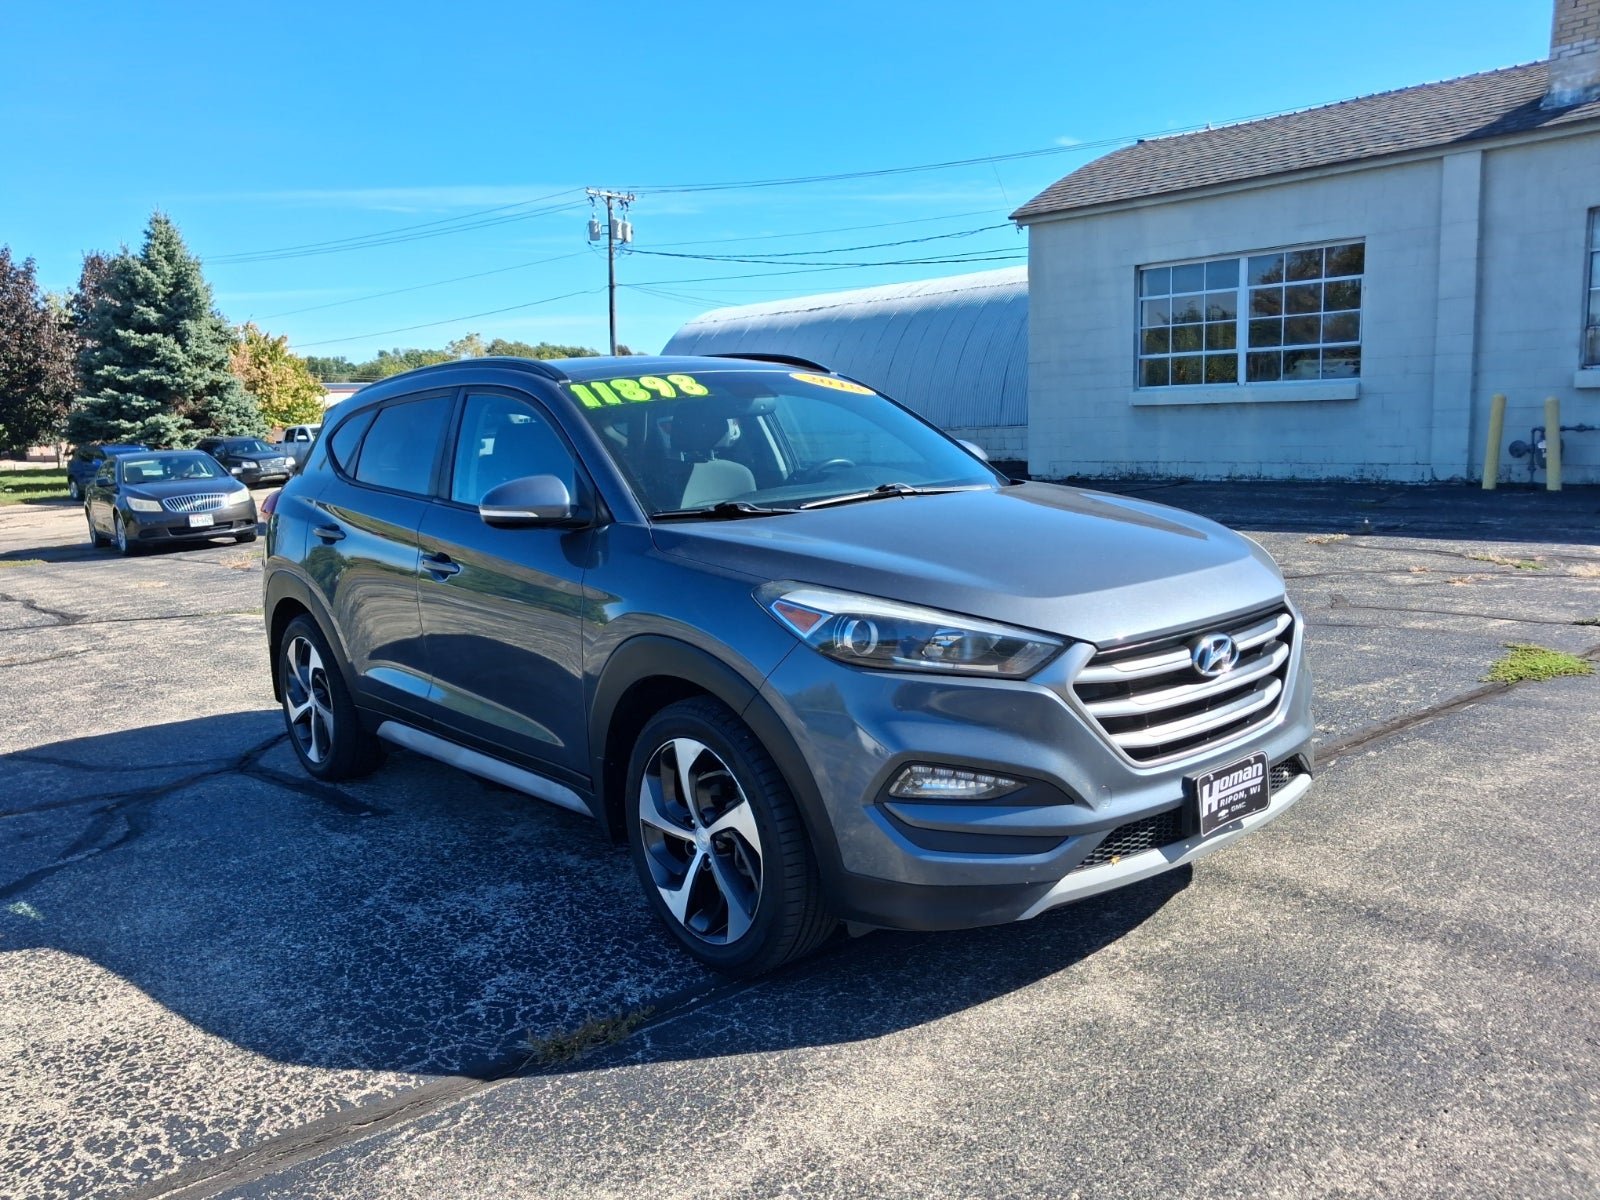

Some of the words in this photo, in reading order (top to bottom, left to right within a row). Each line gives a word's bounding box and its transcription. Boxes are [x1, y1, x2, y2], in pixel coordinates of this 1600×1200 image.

[570, 374, 709, 408] 11898
[1202, 763, 1264, 818] Homan
[1219, 792, 1248, 808] RIPON,
[1250, 785, 1261, 795] WI
[1230, 801, 1247, 812] GMC
